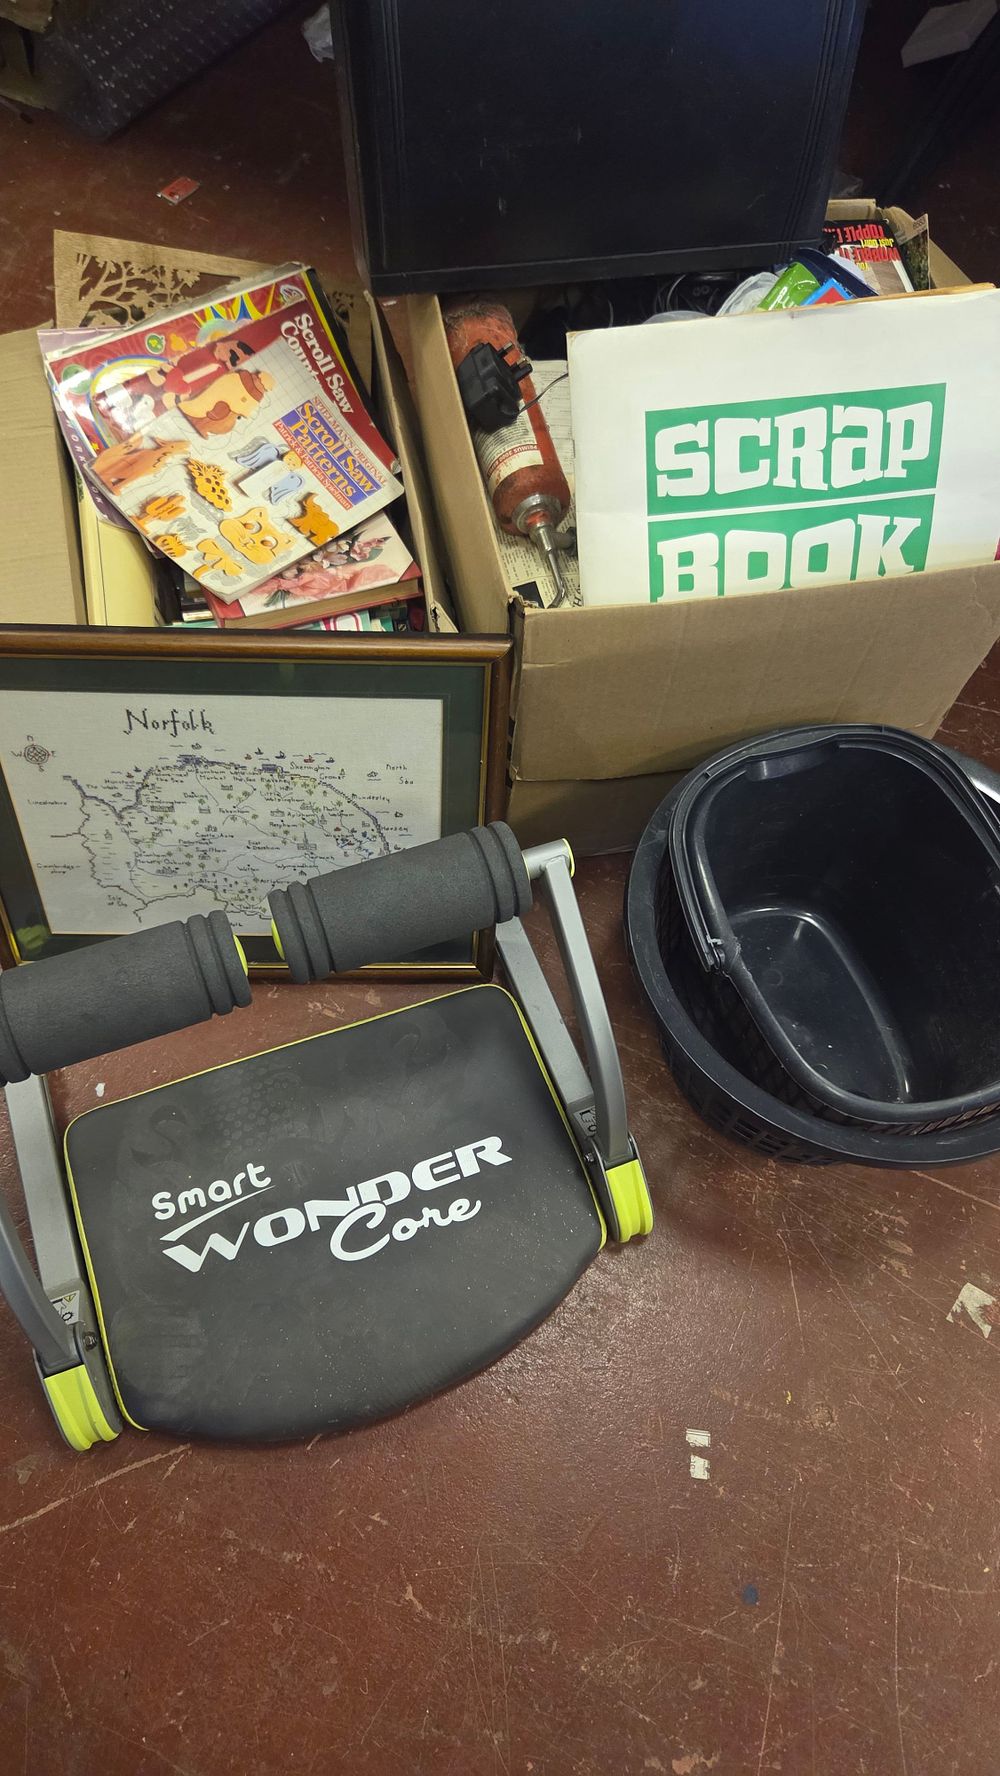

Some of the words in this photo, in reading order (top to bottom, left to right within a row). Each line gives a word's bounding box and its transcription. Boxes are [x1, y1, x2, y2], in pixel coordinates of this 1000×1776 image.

[844, 224, 885, 242] TOPPLE
[294, 313, 336, 375] Scroll
[326, 373, 354, 414] Saw
[275, 420, 298, 453] Patrick
[301, 453, 327, 485] Patricia
[323, 480, 352, 509] Spielman
[289, 420, 356, 498] Patterns
[301, 402, 344, 463] Scroll
[341, 456, 377, 493] Saw
[353, 448, 388, 486] ORIGINAL
[656, 514, 922, 602] BOOK
[123, 707, 216, 738] Norfolk
[151, 1163, 272, 1220] Smart
[162, 1136, 513, 1273] WONDER
[330, 1198, 482, 1262] Core
